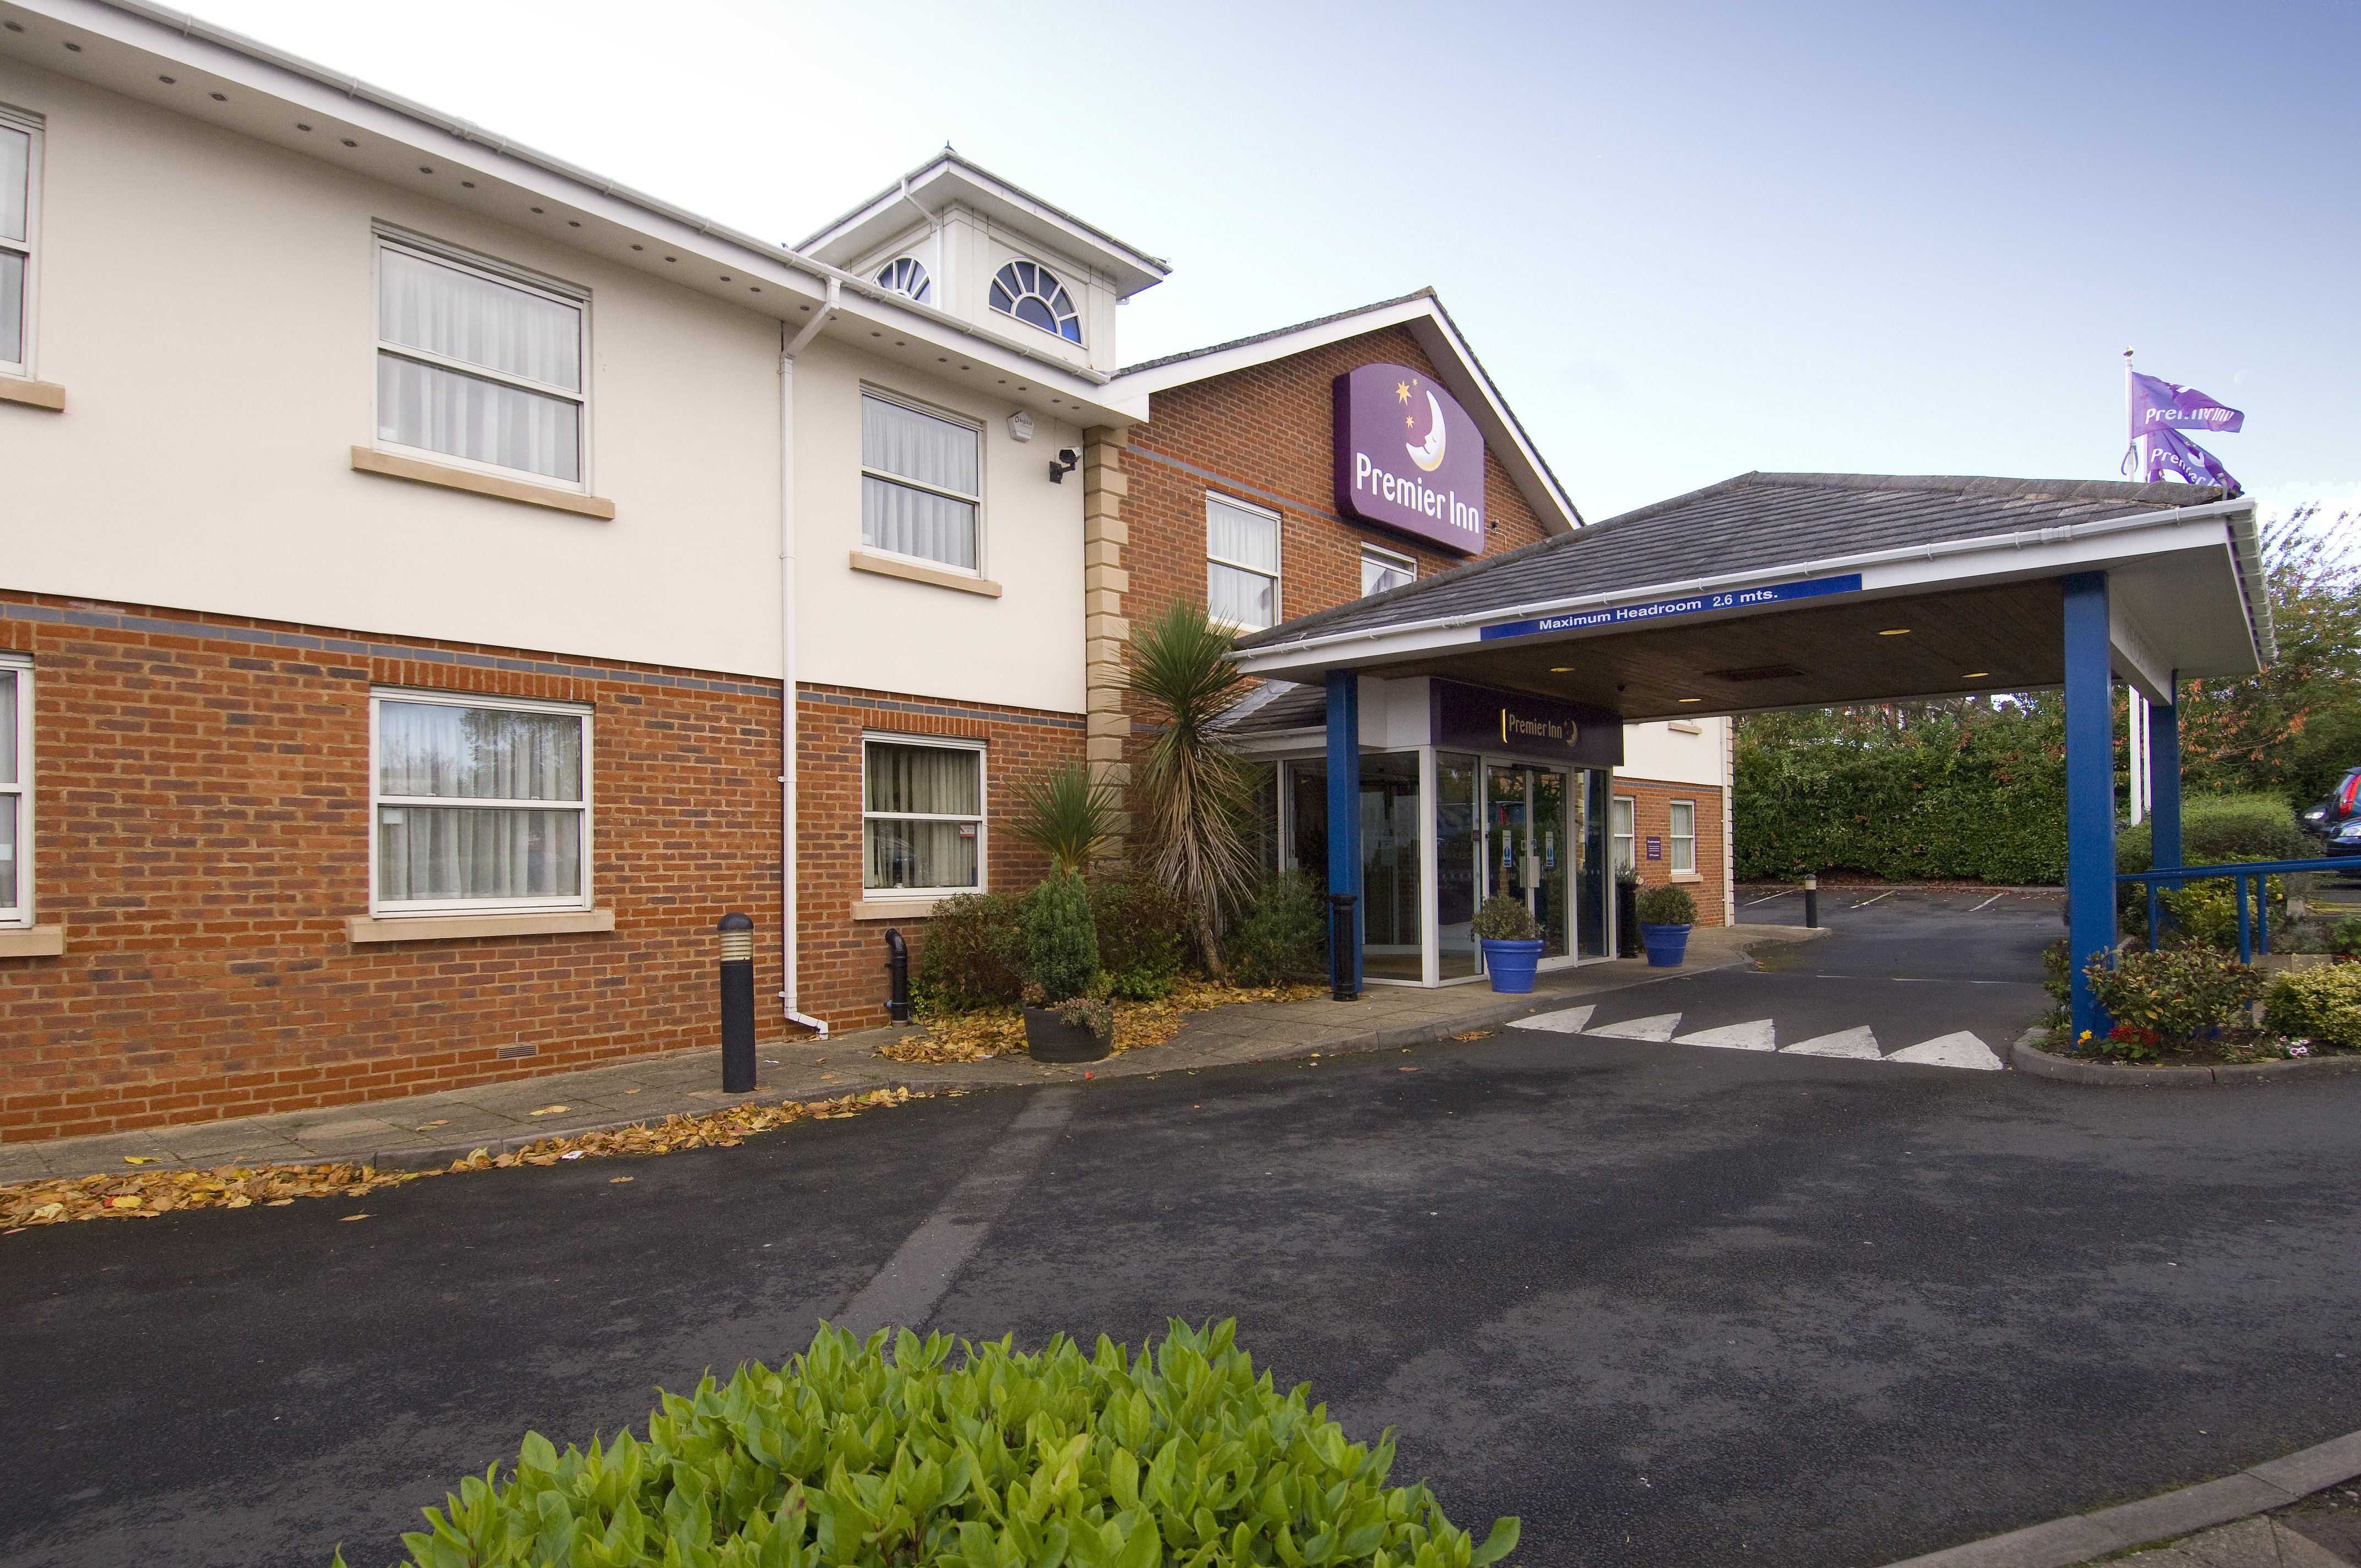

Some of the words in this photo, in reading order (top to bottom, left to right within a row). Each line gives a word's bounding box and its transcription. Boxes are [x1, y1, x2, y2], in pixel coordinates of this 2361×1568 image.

[1356, 452, 1446, 519] Premier
[1450, 491, 1479, 533] Inn
[1539, 612, 1611, 630] Maximum
[1616, 599, 1701, 620] Headroom
[1712, 595, 1733, 607] 2.6
[1740, 590, 1778, 604] mts.
[1509, 714, 1547, 737] Premier
[1548, 721, 1562, 739] Inn
